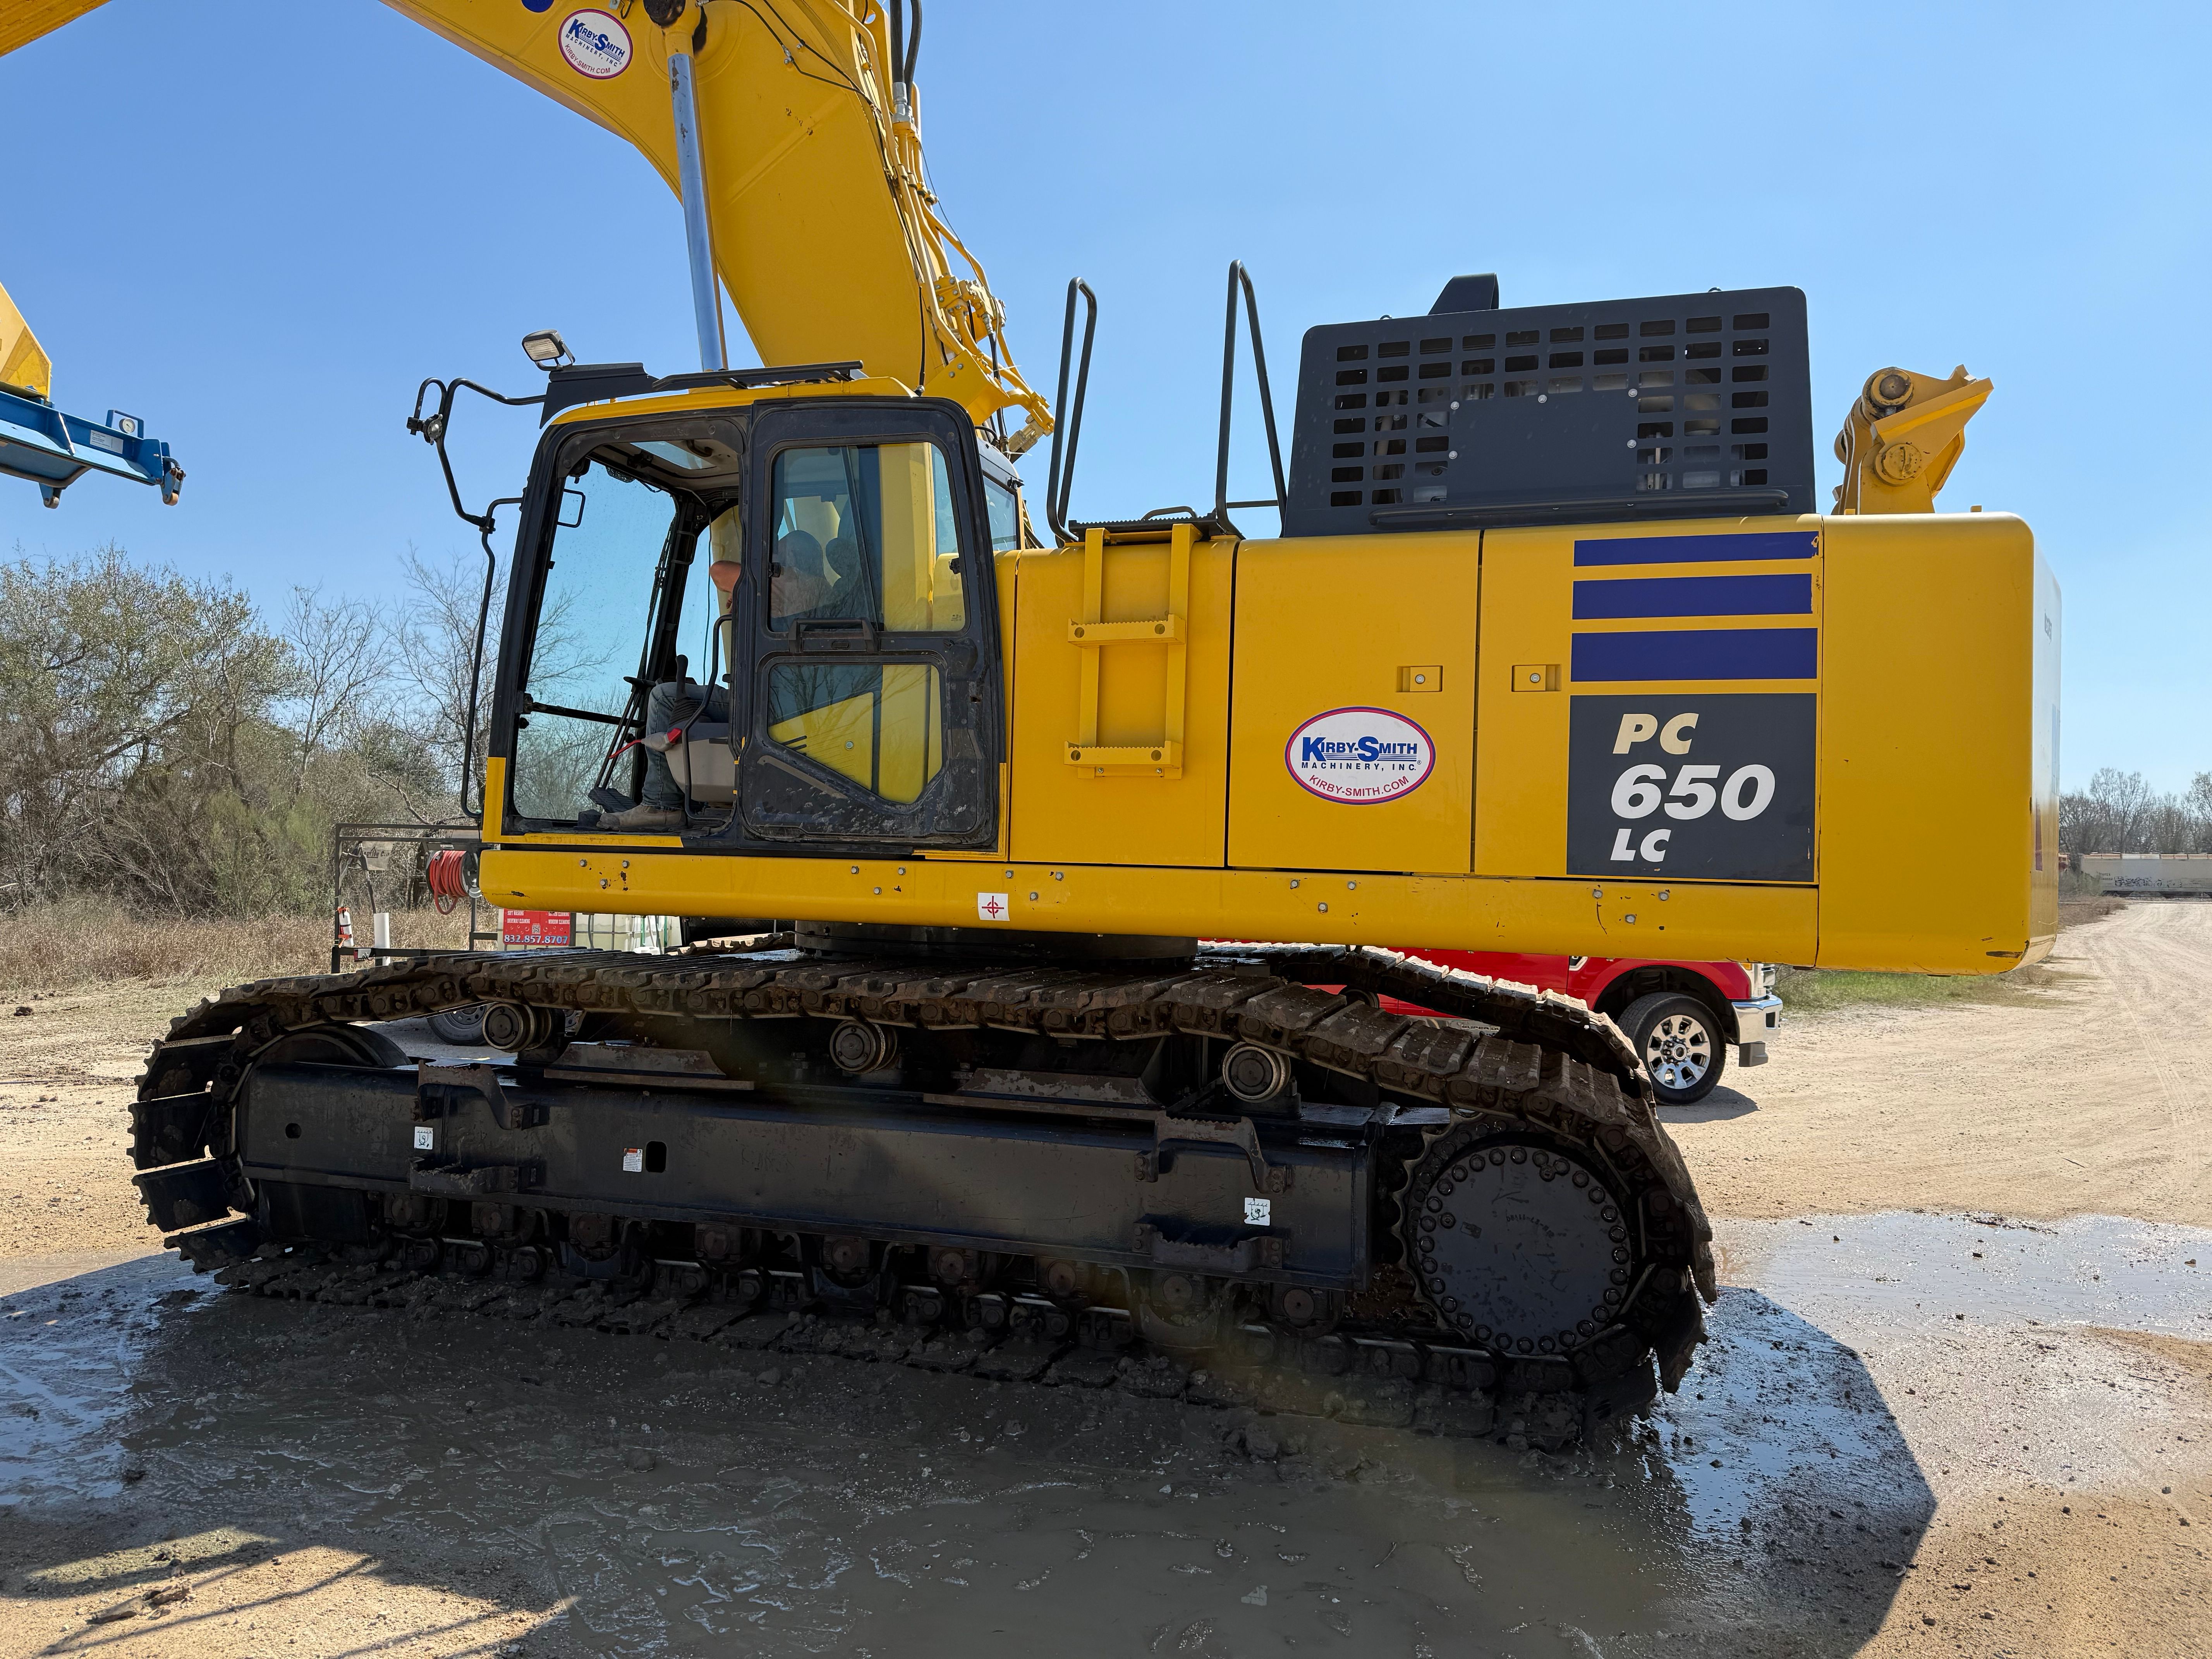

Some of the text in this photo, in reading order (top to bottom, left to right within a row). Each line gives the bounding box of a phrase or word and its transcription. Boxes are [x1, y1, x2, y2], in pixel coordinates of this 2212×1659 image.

[565, 33, 603, 59] MACHINERY,
[565, 44, 610, 74] KIRBY-SMITH.COM
[1613, 713, 1699, 754] PC
[1302, 762, 1384, 771] MACHINERY,
[1309, 775, 1409, 796] KIRBY-SMITH.COM
[1611, 764, 1776, 821] 650
[1610, 828, 1671, 862] LC
[504, 934, 568, 944] 832.857.8707
